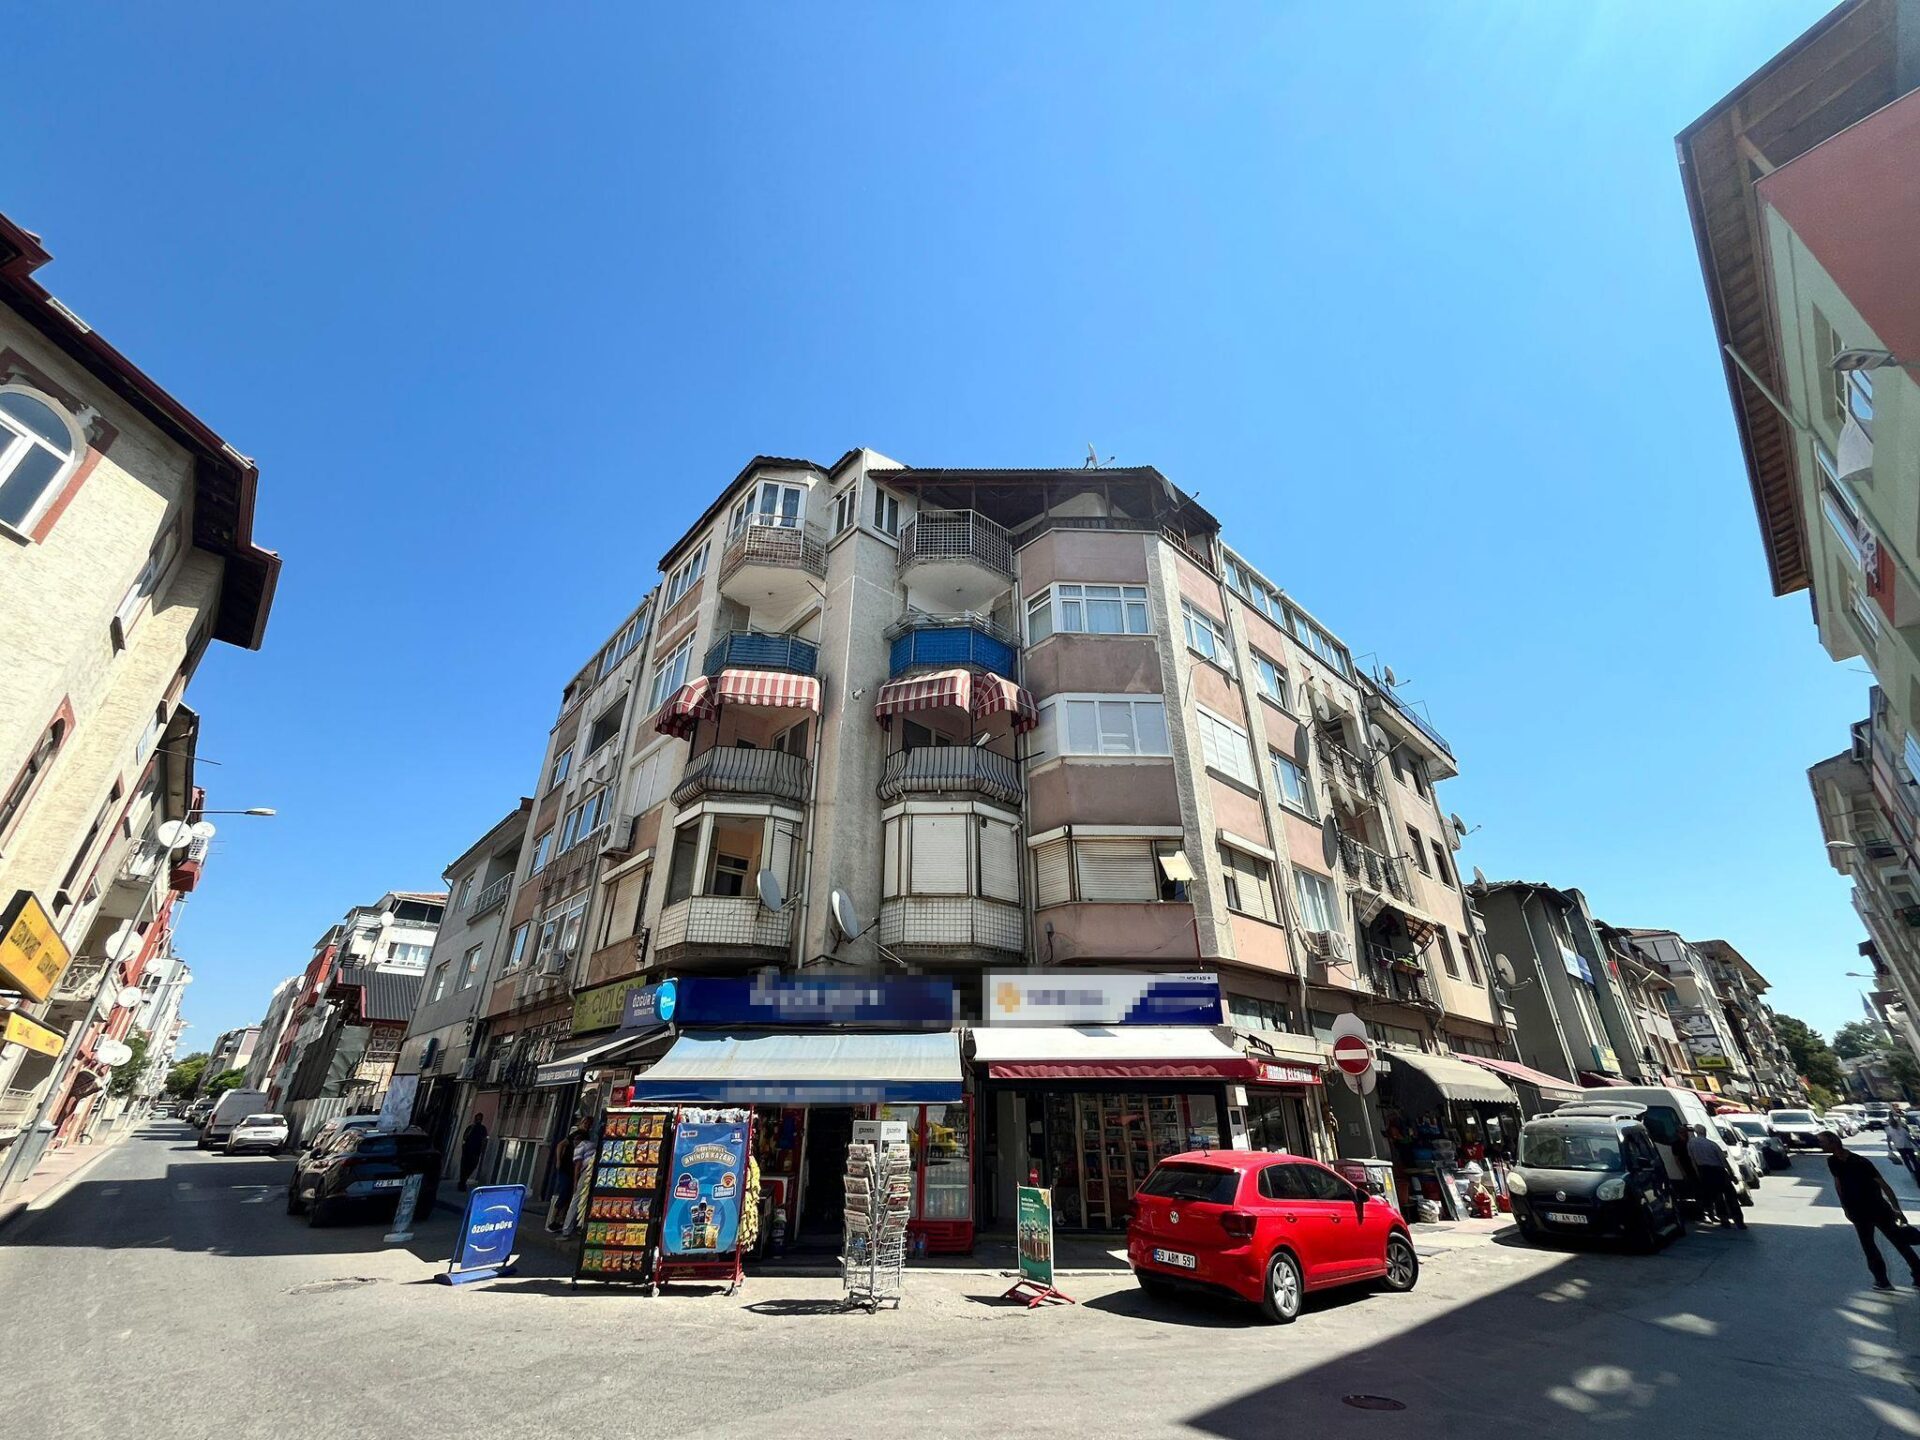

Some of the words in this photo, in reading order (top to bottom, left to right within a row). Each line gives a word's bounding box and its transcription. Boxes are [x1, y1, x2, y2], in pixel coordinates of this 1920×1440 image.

[471, 1222, 495, 1233] ÖZGÜR
[495, 1220, 513, 1231] BÜFE
[1157, 1251, 1165, 1261] 59
[1182, 1256, 1194, 1267] 591
